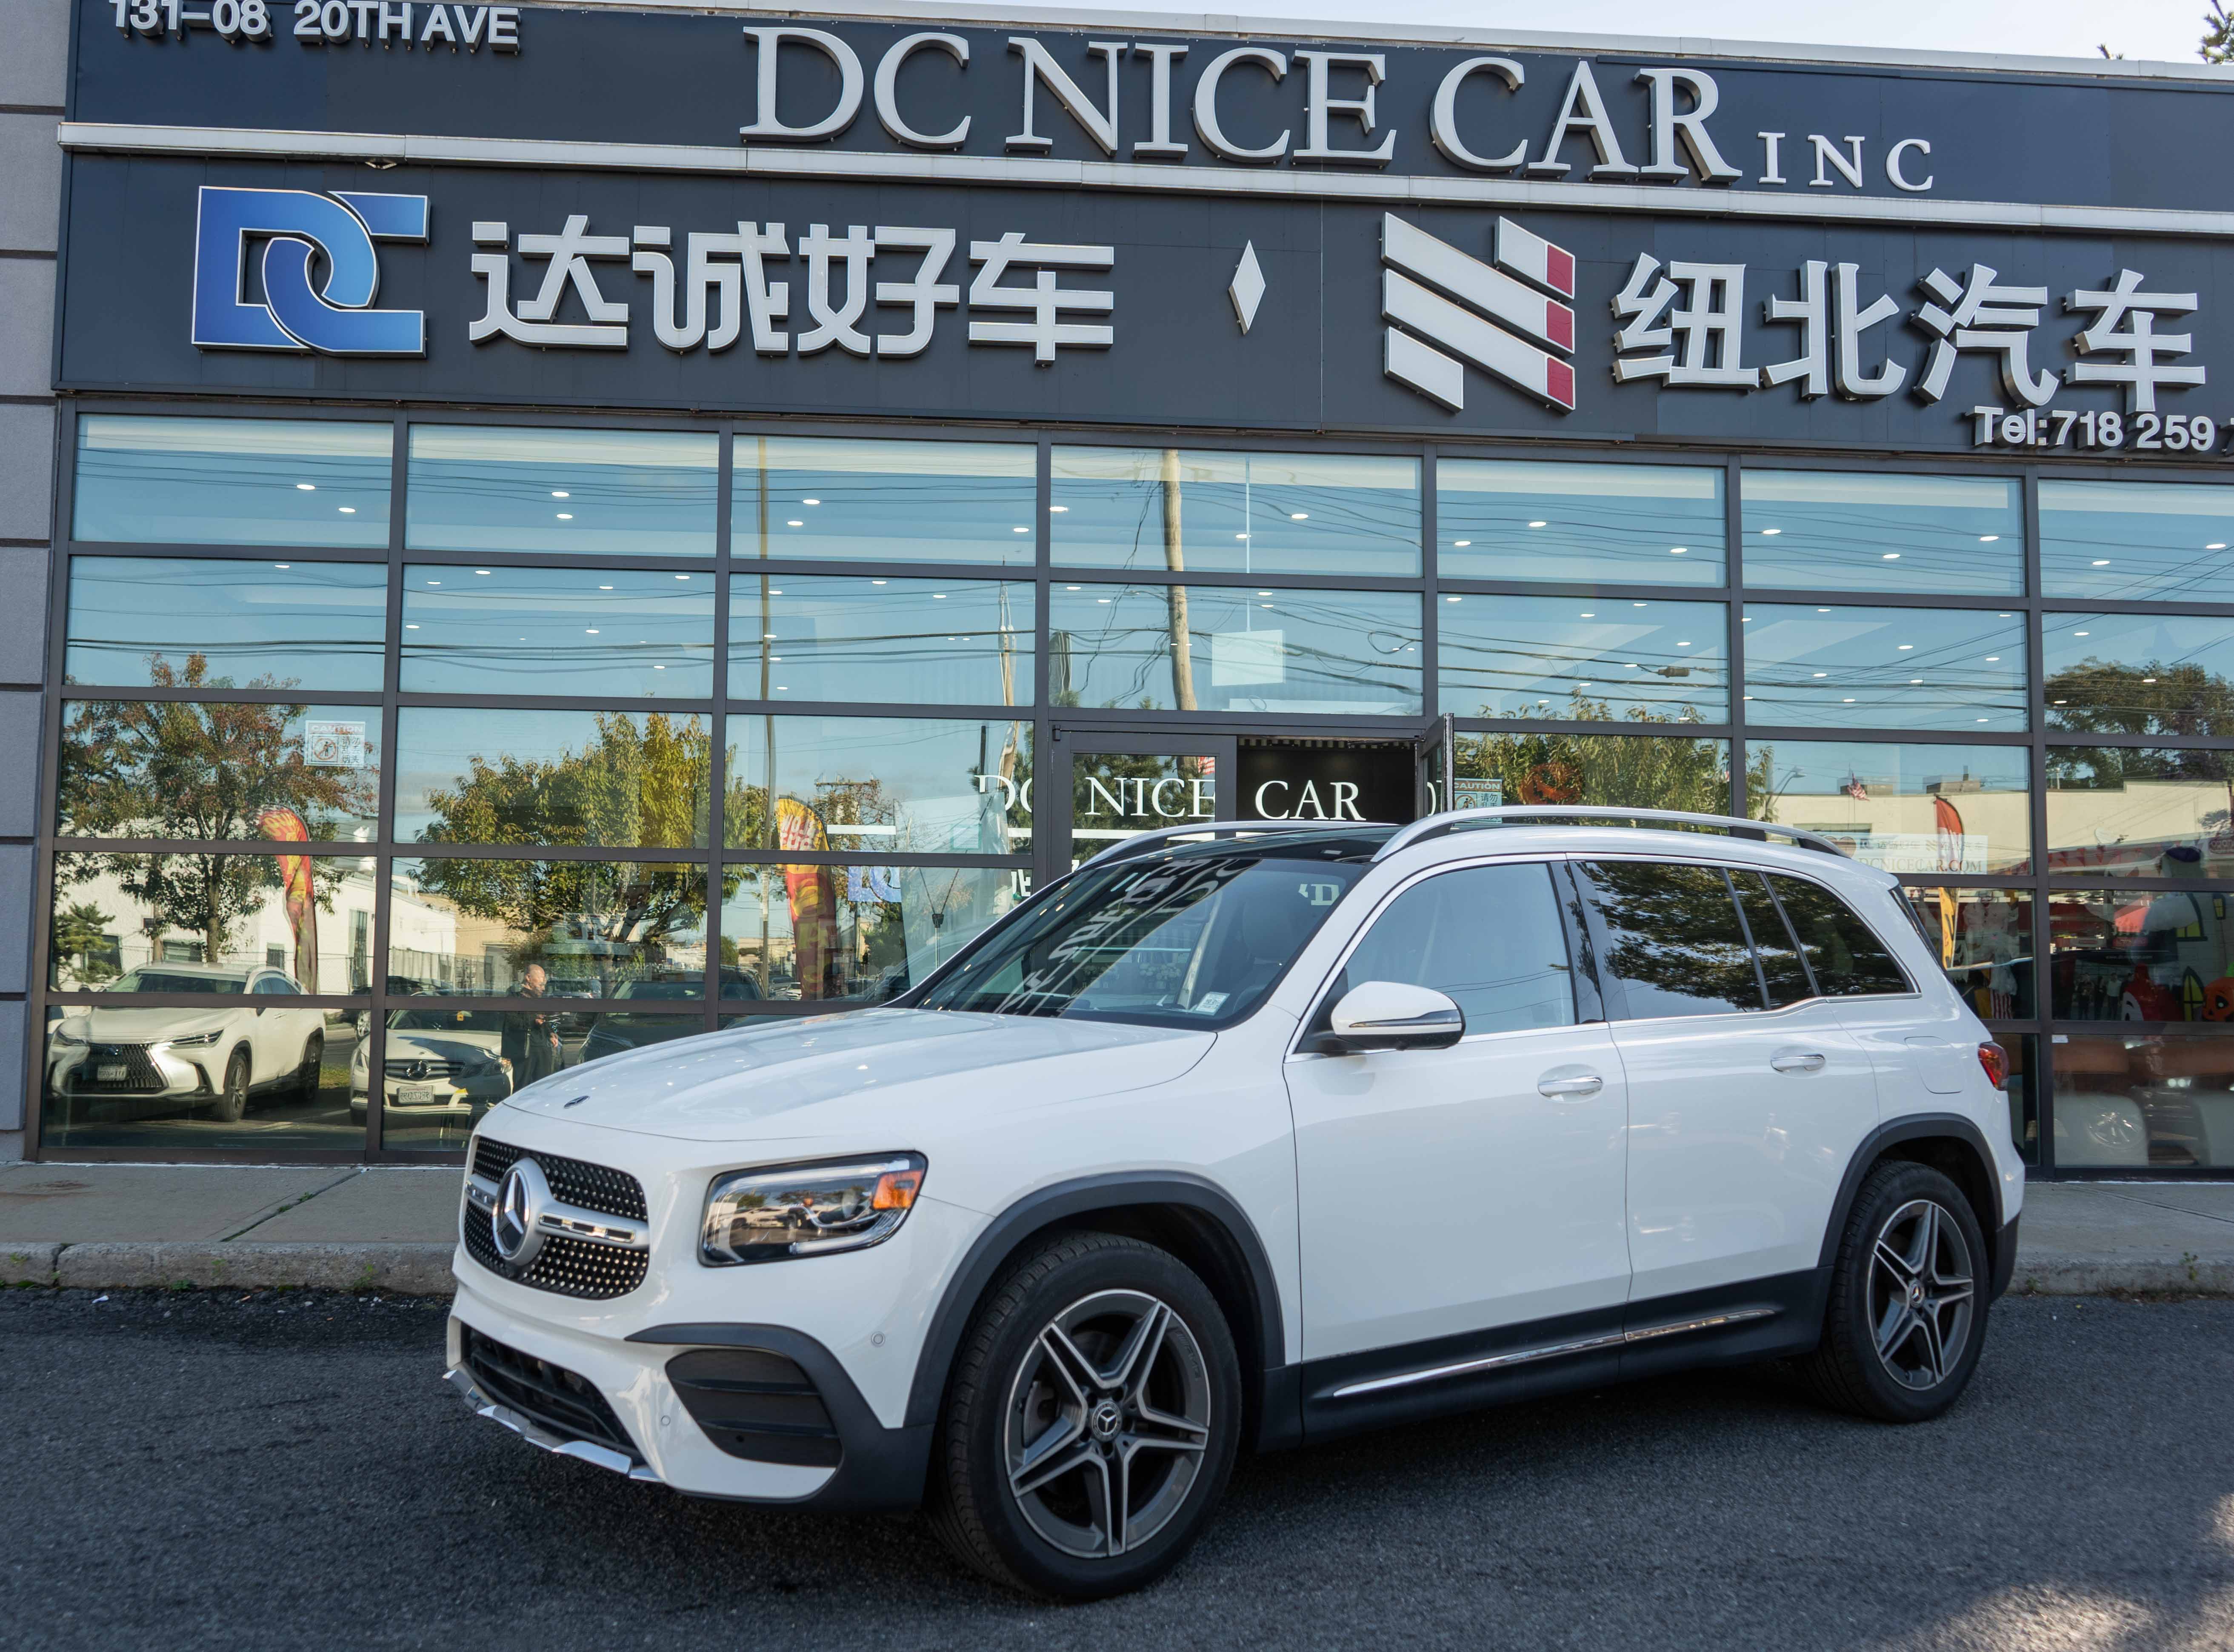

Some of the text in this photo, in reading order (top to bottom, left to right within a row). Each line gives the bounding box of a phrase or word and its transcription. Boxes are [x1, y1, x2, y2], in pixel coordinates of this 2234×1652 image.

[109, 0, 520, 48] 131-08 20TH AVE
[740, 26, 1934, 192] DC NICE CAR INC
[469, 214, 1114, 366] 达诚好车
[1611, 252, 2205, 413] 纽北汽车
[2135, 413, 2215, 451] 259
[1085, 777, 1215, 817] NICE
[1255, 780, 1366, 820] CAR
